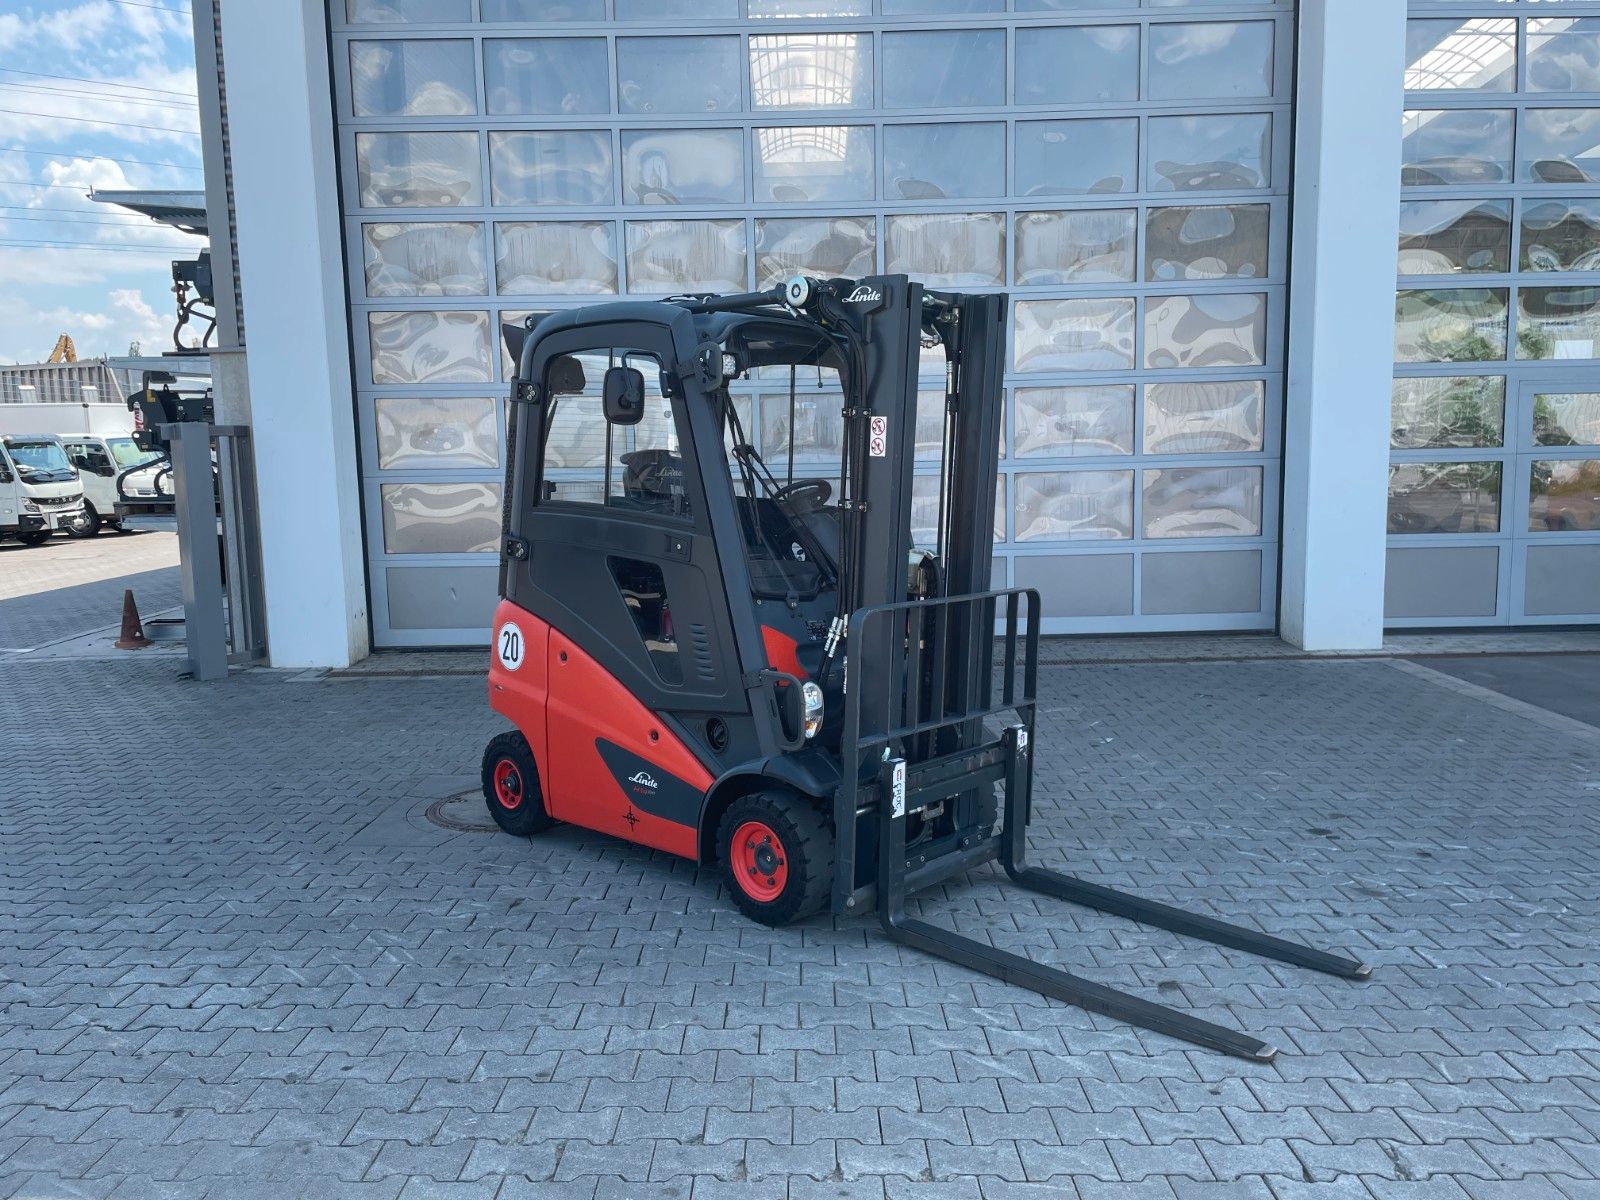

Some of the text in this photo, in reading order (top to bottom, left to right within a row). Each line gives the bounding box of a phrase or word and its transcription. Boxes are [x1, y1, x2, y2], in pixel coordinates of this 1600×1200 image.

[842, 286, 881, 303] Linde
[503, 631, 518, 662] 20
[628, 772, 658, 789] Linde
